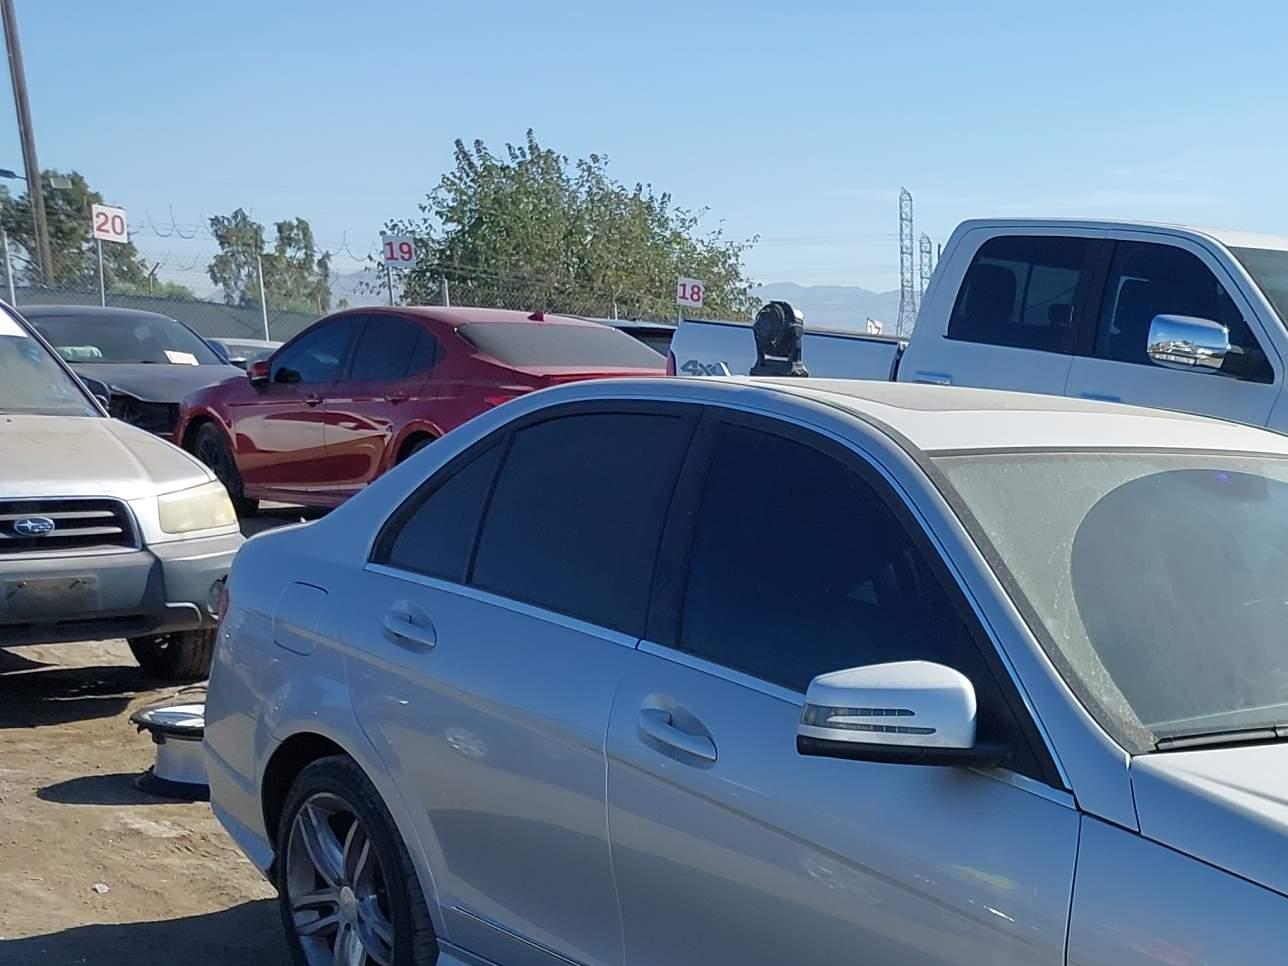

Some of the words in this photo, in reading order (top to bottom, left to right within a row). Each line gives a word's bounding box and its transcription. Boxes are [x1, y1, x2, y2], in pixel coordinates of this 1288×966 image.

[95, 211, 125, 236] 20
[384, 241, 413, 262] 19
[678, 283, 701, 302] 18
